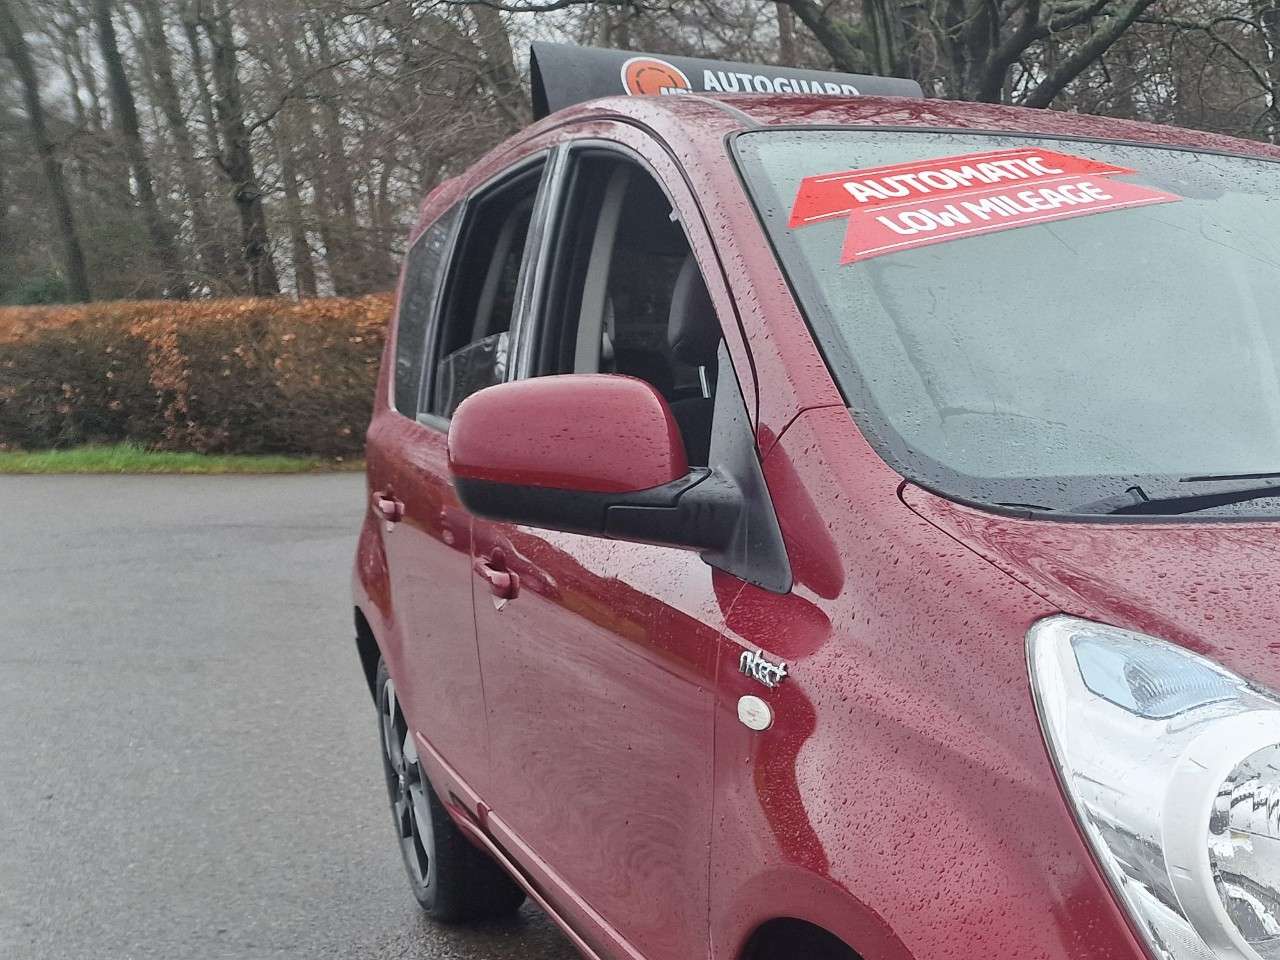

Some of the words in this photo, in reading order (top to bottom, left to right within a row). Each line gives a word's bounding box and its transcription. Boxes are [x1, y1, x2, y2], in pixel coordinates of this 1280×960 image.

[703, 70, 860, 96] AUTOGUARD
[842, 156, 1064, 203] AUTOMATIC
[876, 203, 965, 236] LOW
[966, 181, 1114, 222] MILEAGE
